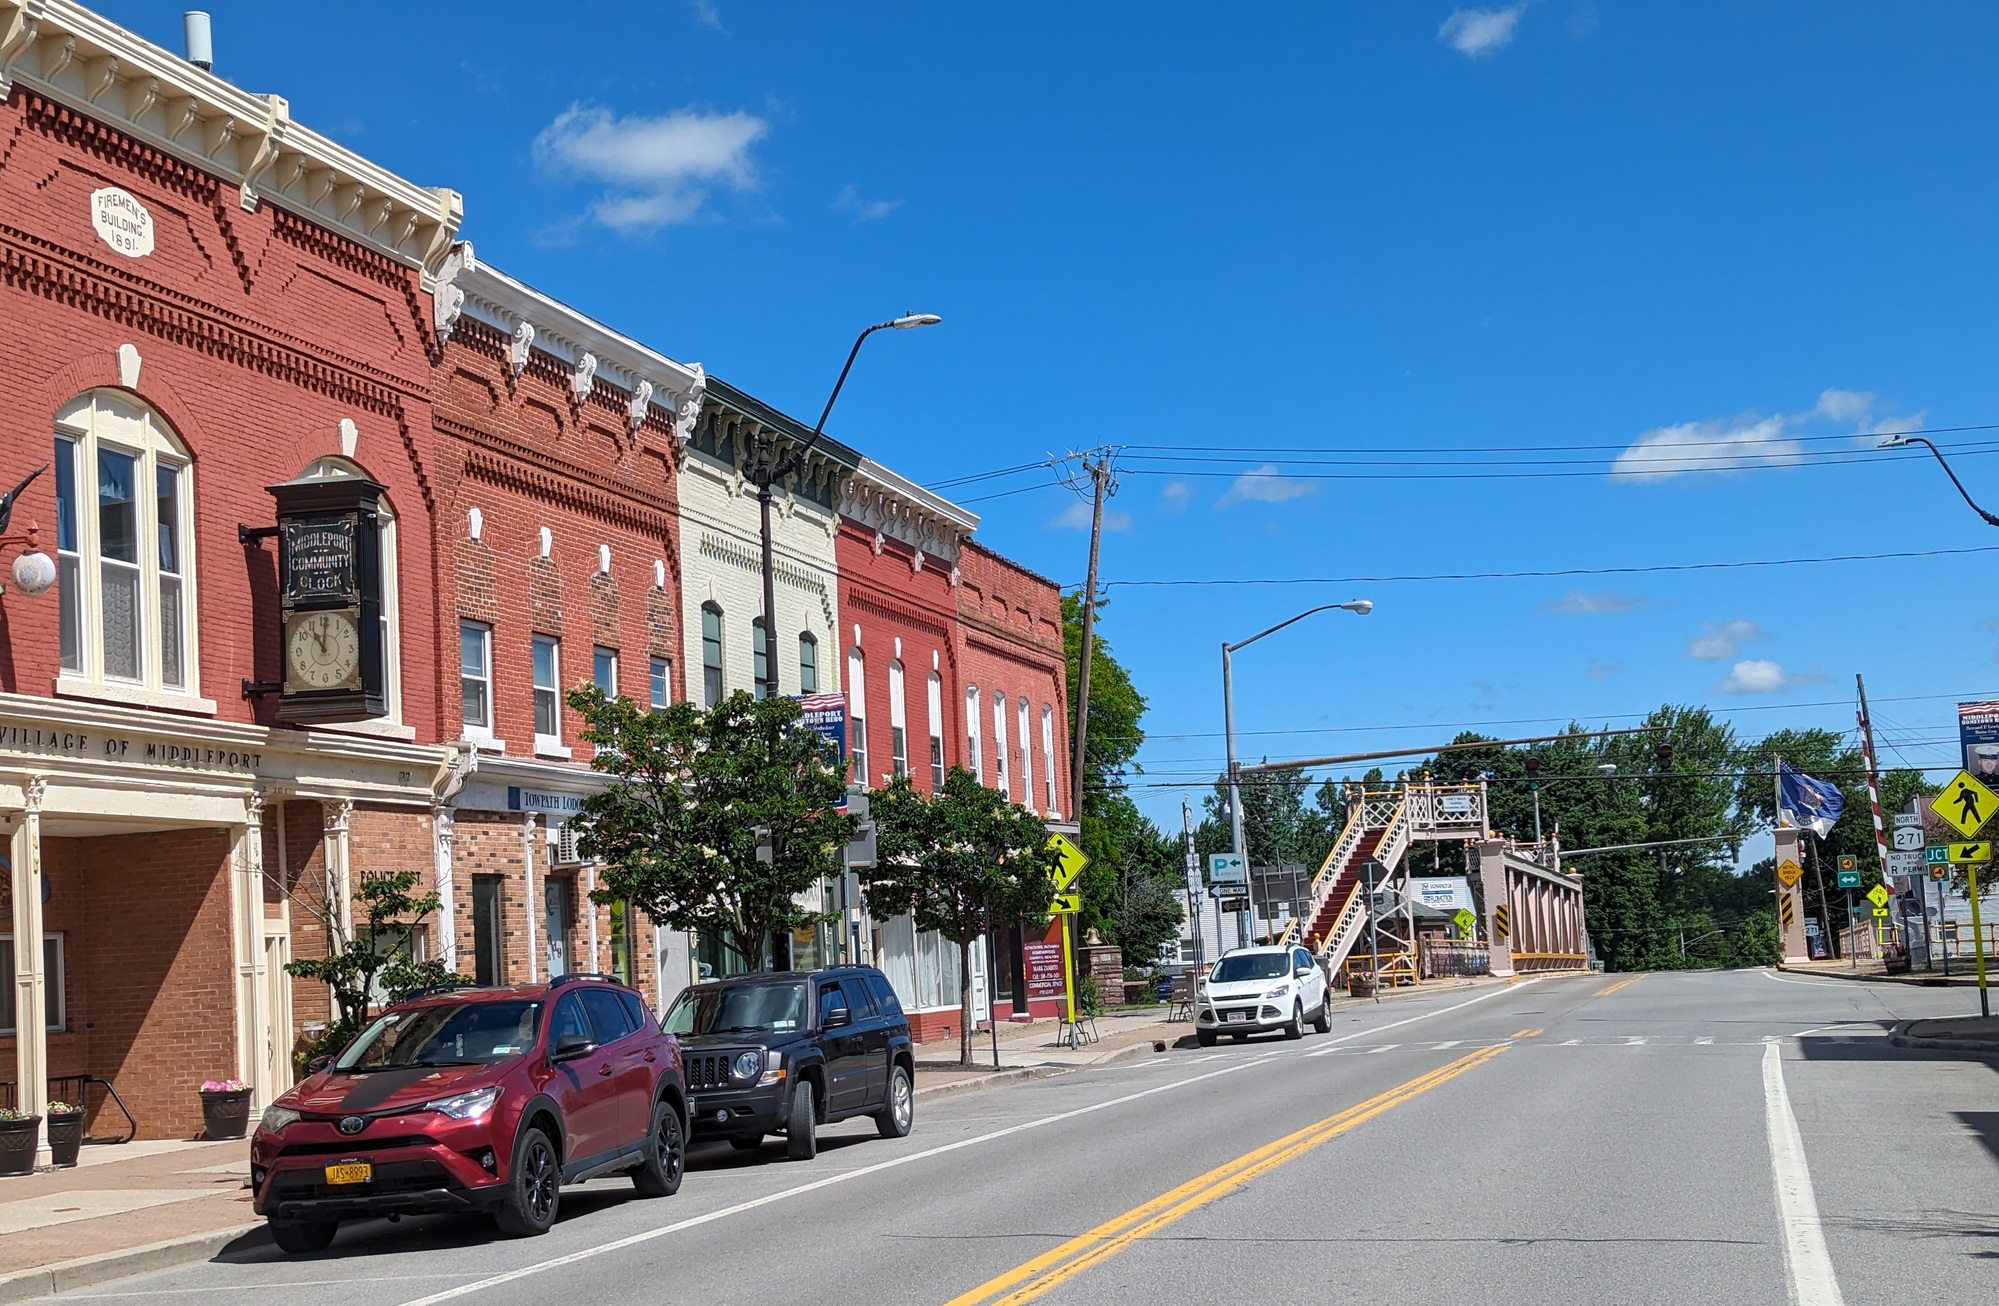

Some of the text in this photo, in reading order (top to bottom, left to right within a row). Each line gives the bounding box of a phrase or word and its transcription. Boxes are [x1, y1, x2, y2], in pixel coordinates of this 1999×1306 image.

[97, 194, 147, 226] FIREMEN'S
[101, 210, 146, 239] BUILDING.
[292, 532, 349, 555] MIDDLEPORT
[292, 554, 349, 571] COMMUNITY
[300, 573, 342, 590] CLOCK
[299, 631, 308, 642] 10
[344, 629, 350, 639] 2
[295, 647, 303, 658] 9
[348, 644, 354, 654] 3
[300, 660, 307, 671] 8
[344, 659, 351, 669] 4
[310, 671, 316, 681] 7
[322, 673, 329, 684] 6
[335, 669, 342, 680] 5
[0, 726, 262, 769] VILLAGE OF MIDDLEPORT
[524, 792, 560, 809] TOWPATH
[1896, 816, 1918, 824] NORTH
[1896, 833, 1921, 845] 271
[1928, 849, 1948, 861] JCT
[1891, 866, 1898, 874] R
